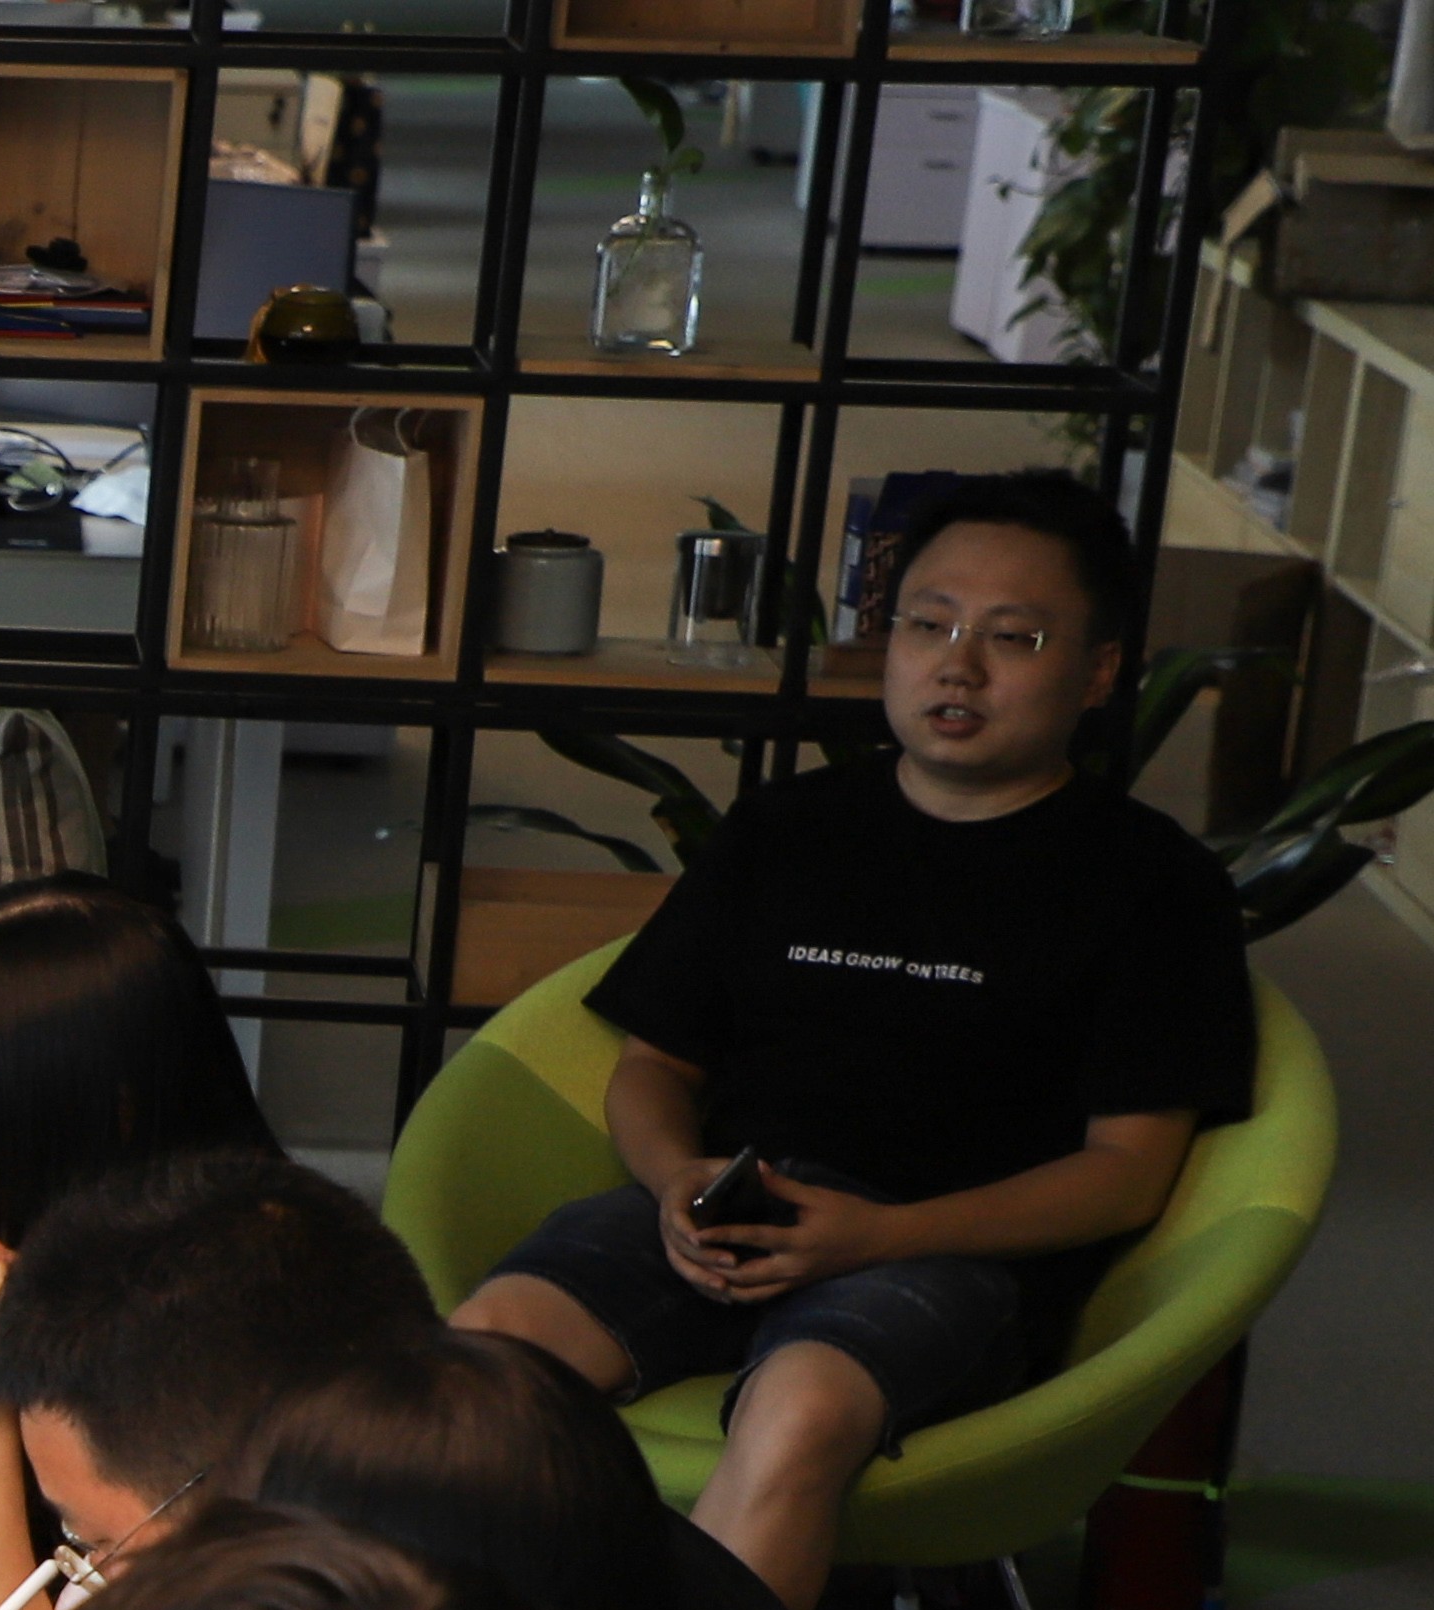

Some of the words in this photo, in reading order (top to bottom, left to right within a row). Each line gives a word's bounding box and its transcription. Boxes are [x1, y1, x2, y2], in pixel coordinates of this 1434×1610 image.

[788, 945, 844, 965] IDEAS
[845, 952, 903, 969] GROW
[906, 962, 932, 979] ON
[934, 964, 985, 984] TREES
